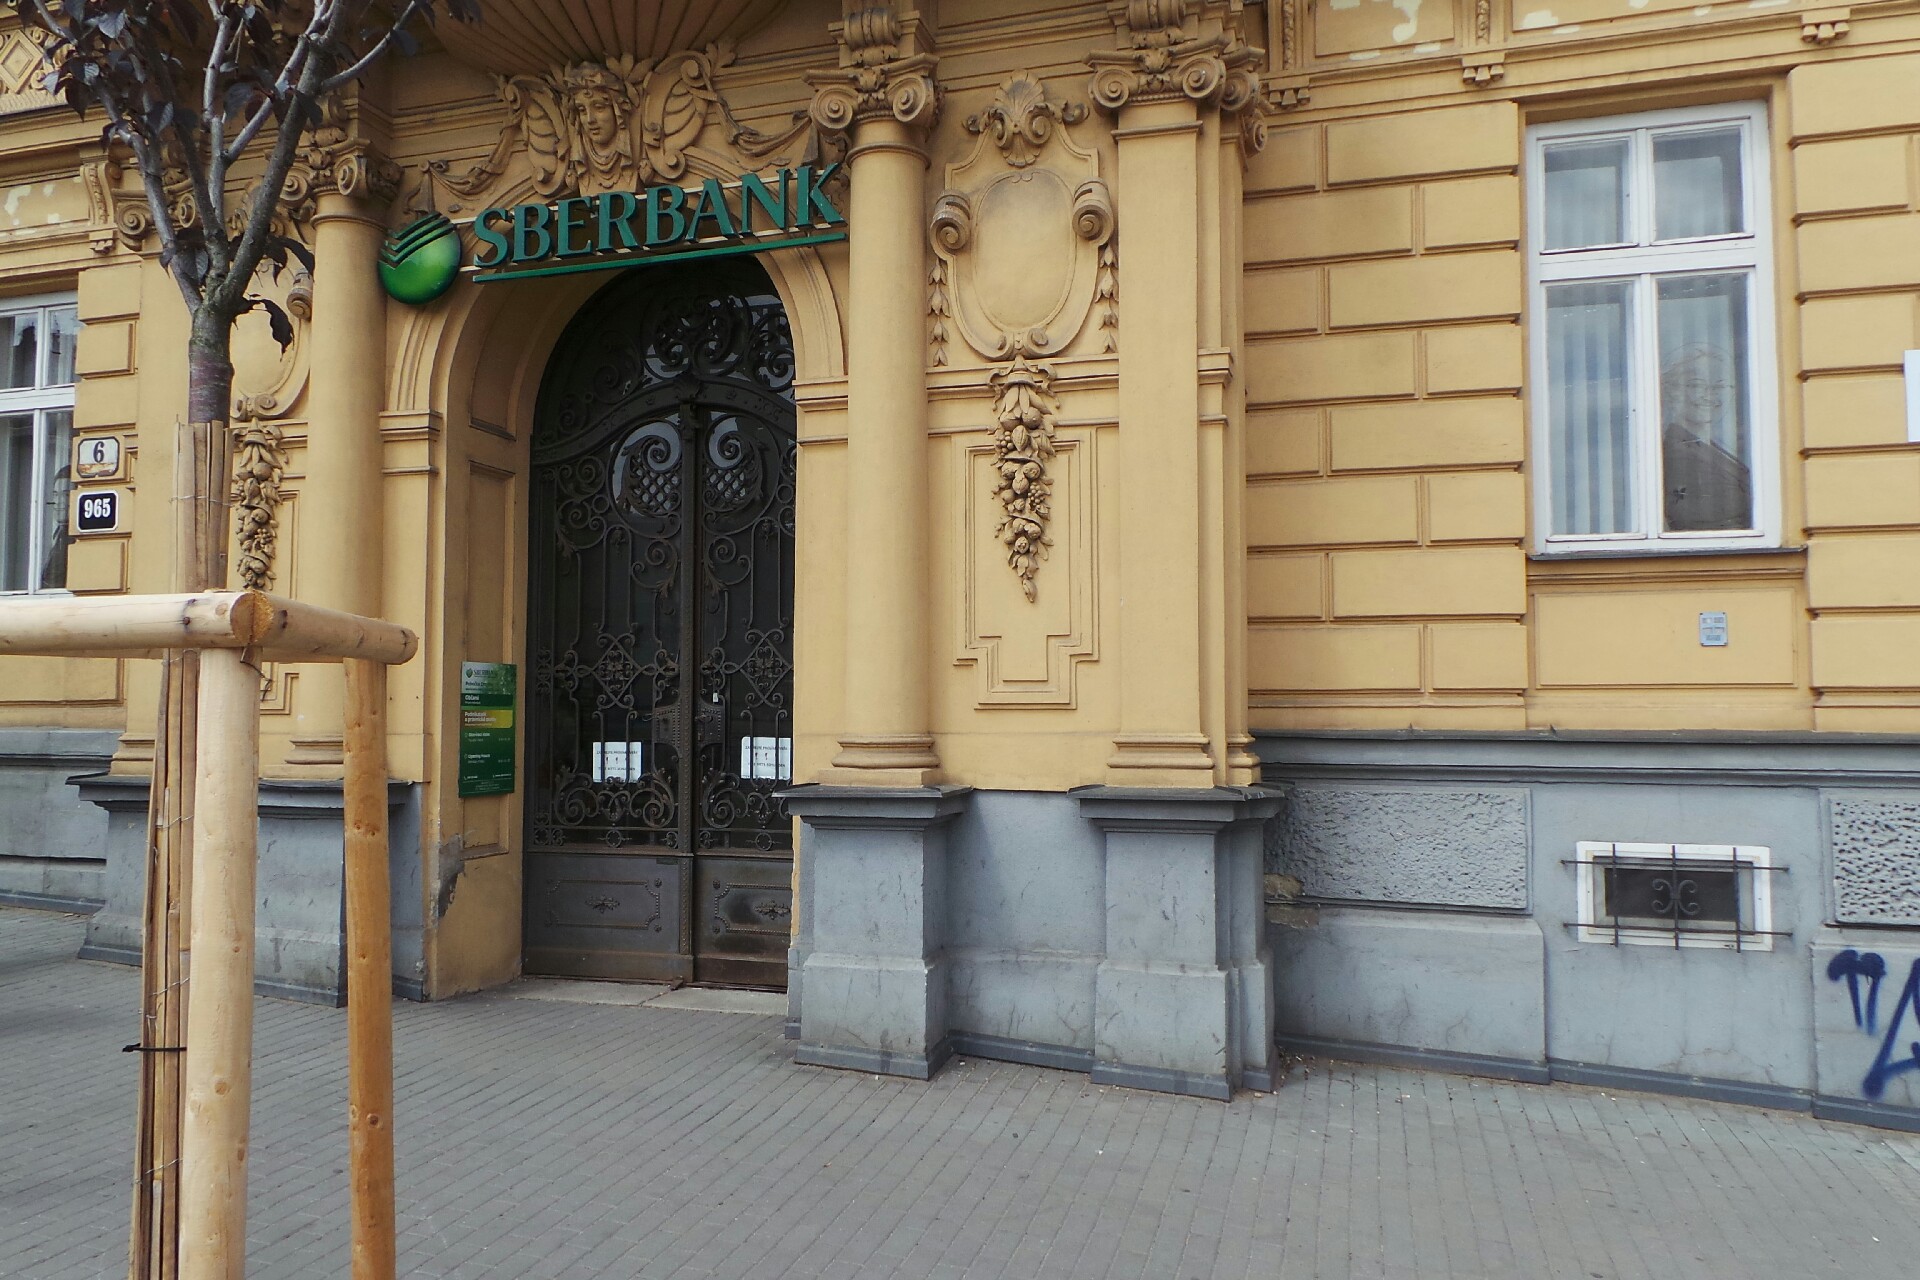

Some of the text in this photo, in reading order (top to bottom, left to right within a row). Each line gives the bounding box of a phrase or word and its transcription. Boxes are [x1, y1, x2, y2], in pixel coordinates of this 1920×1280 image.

[473, 163, 847, 268] SBERBANK
[93, 441, 105, 463] 6
[84, 498, 111, 518] 965
